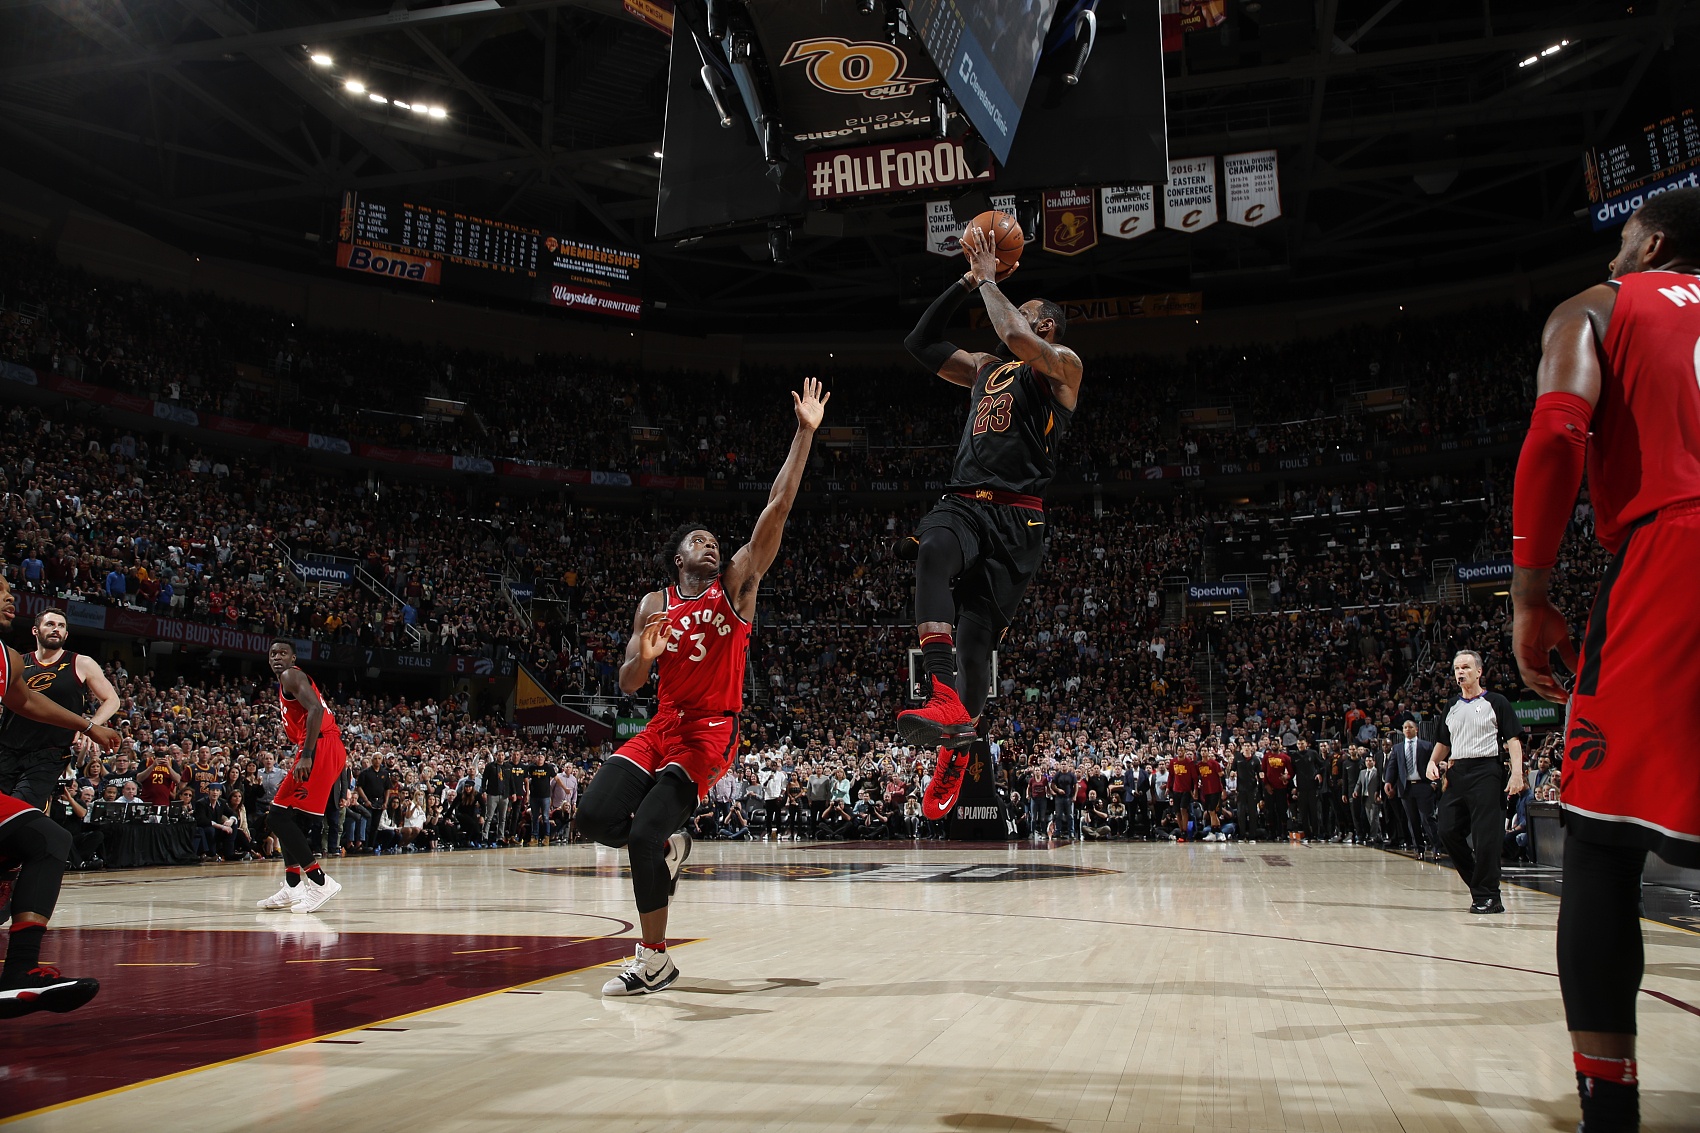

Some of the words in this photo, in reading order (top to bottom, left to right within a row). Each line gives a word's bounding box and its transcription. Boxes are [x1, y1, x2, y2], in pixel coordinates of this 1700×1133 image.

[969, 71, 995, 117] Cleveland
[993, 108, 1008, 137] Clinic
[845, 109, 914, 126] Arena
[794, 126, 868, 142] Loans
[1225, 159, 1249, 168] CENTRAL
[1251, 156, 1276, 165] DIVISION
[1610, 151, 1630, 165] JAMES
[1171, 163, 1206, 175] 2016-17
[1228, 163, 1273, 175] CHAMPIONS
[1611, 160, 1626, 171] LOVE
[1612, 164, 1635, 178] KORVER
[1172, 175, 1206, 186] EASTERN
[1167, 185, 1213, 197] CONFERENCE
[1046, 195, 1091, 208] CHAMPIONS
[1107, 202, 1149, 214] CHAMPIONS
[1169, 195, 1211, 208] CHAMPIONS
[1597, 195, 1644, 222] drug
[560, 244, 640, 269] MEMBERSHIPS
[619, 250, 641, 260] UNITED
[347, 245, 427, 281] Bona
[552, 284, 597, 306] Wayside
[597, 298, 641, 314] FURNITURE
[973, 392, 1014, 436] 23
[1279, 458, 1309, 469] FOULS
[1179, 465, 1200, 477] 103
[871, 481, 899, 490] FOULS
[975, 489, 994, 501] CAVS
[295, 563, 347, 579] Spectrum
[1458, 564, 1512, 579] Spectrum
[1190, 586, 1240, 599] Spectrum
[155, 617, 184, 639] THIS
[185, 622, 220, 644] BUD'S
[221, 628, 245, 648] FOR
[246, 632, 270, 653] YOU
[666, 608, 732, 653] RAPTORS
[688, 632, 707, 662] 3
[397, 655, 431, 667] STEALS
[456, 658, 465, 672] 5
[1515, 706, 1555, 721] ntington
[152, 773, 164, 785] 23
[963, 805, 998, 820] PLAYOFFS
